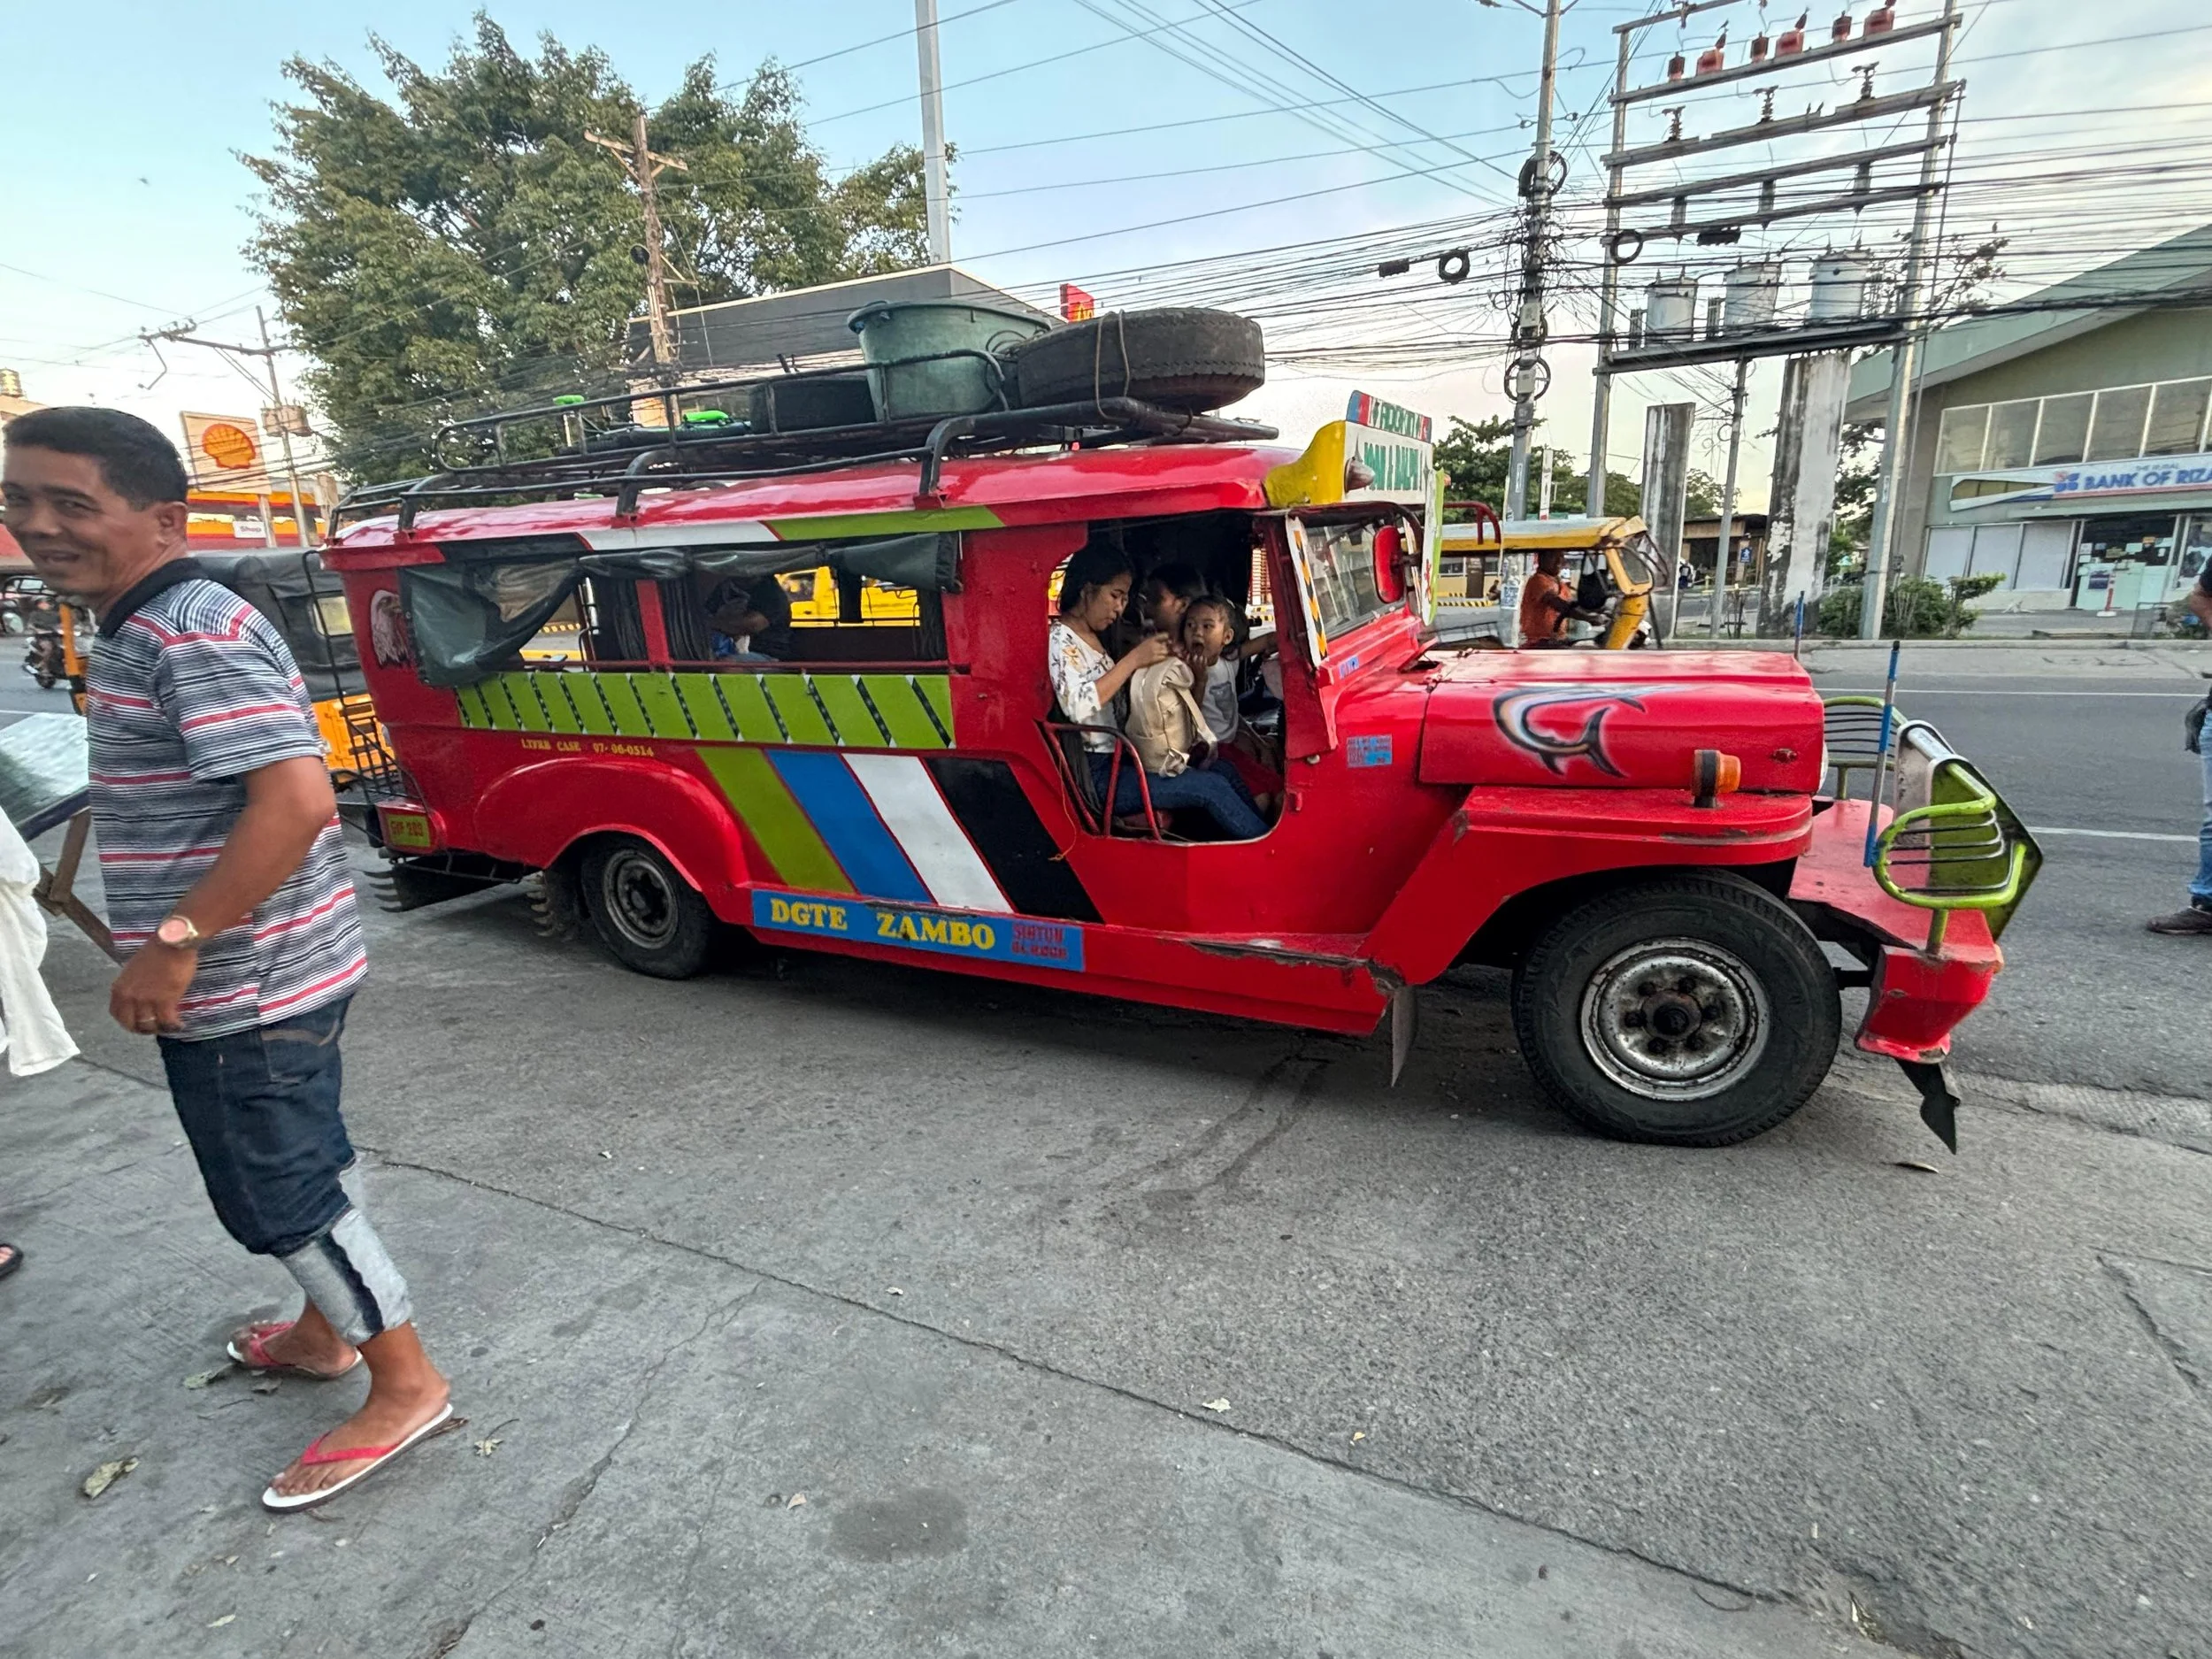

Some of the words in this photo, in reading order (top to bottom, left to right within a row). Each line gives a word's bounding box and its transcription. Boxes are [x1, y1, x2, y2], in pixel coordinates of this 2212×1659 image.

[2083, 472, 2139, 490] BANK
[2142, 471, 2172, 487] OF
[770, 898, 848, 930] DGTE
[876, 911, 996, 950] ZAMBO
